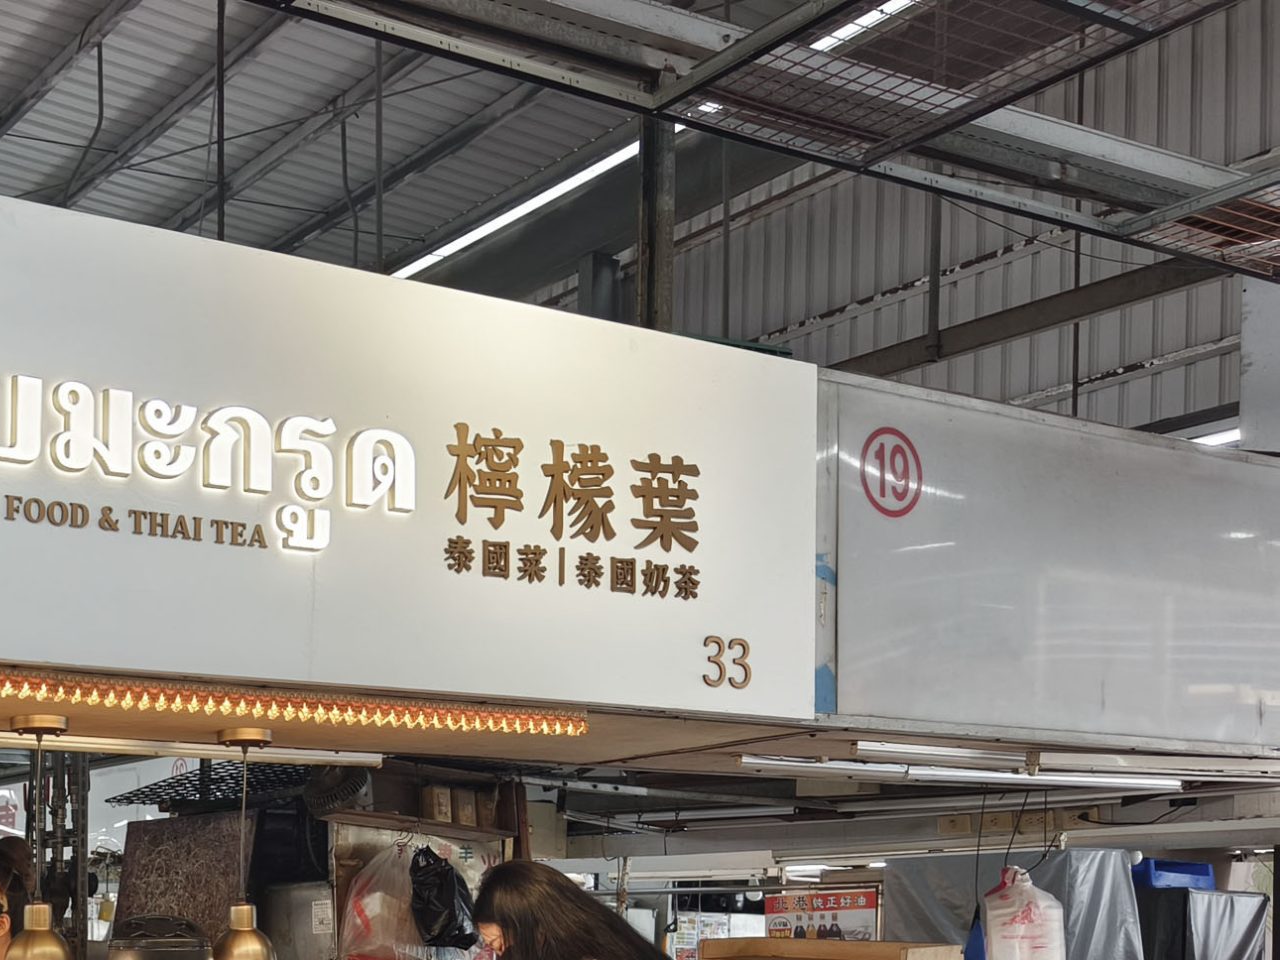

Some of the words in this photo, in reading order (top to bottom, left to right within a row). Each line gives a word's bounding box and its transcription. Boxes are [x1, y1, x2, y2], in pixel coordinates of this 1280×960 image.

[444, 422, 701, 553] 檸檬葉
[874, 442, 910, 501] 19
[4, 496, 90, 530] FOOD
[98, 505, 120, 533] &
[128, 509, 202, 542] THAI
[210, 519, 268, 549] TEA
[702, 635, 752, 689] 33
